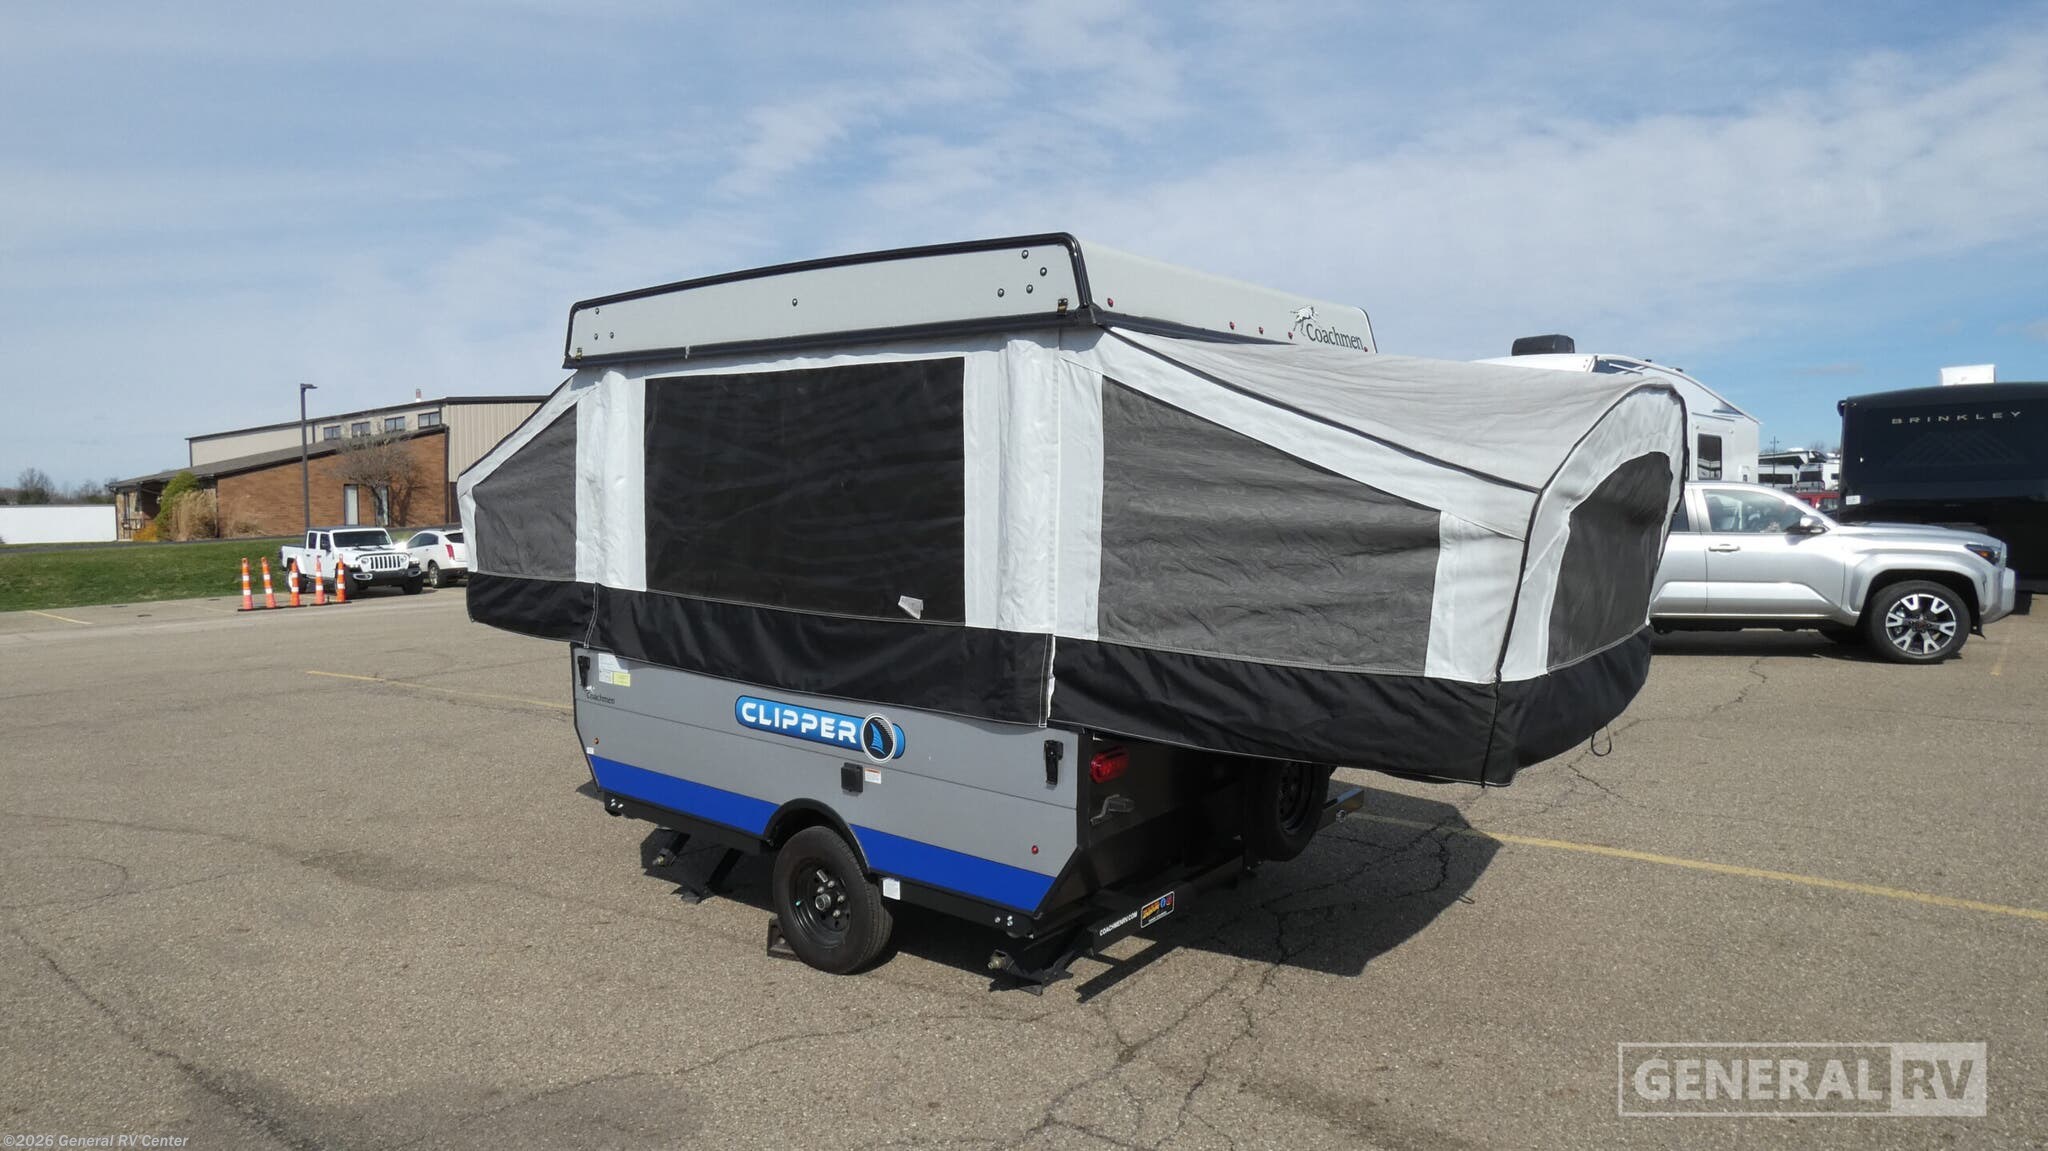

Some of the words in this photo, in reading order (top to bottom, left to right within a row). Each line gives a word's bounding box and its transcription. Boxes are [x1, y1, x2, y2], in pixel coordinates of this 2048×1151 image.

[1306, 323, 1364, 350] Coachmen
[1891, 411, 2021, 424] BRINKLEY
[741, 701, 857, 744] CLIPPER
